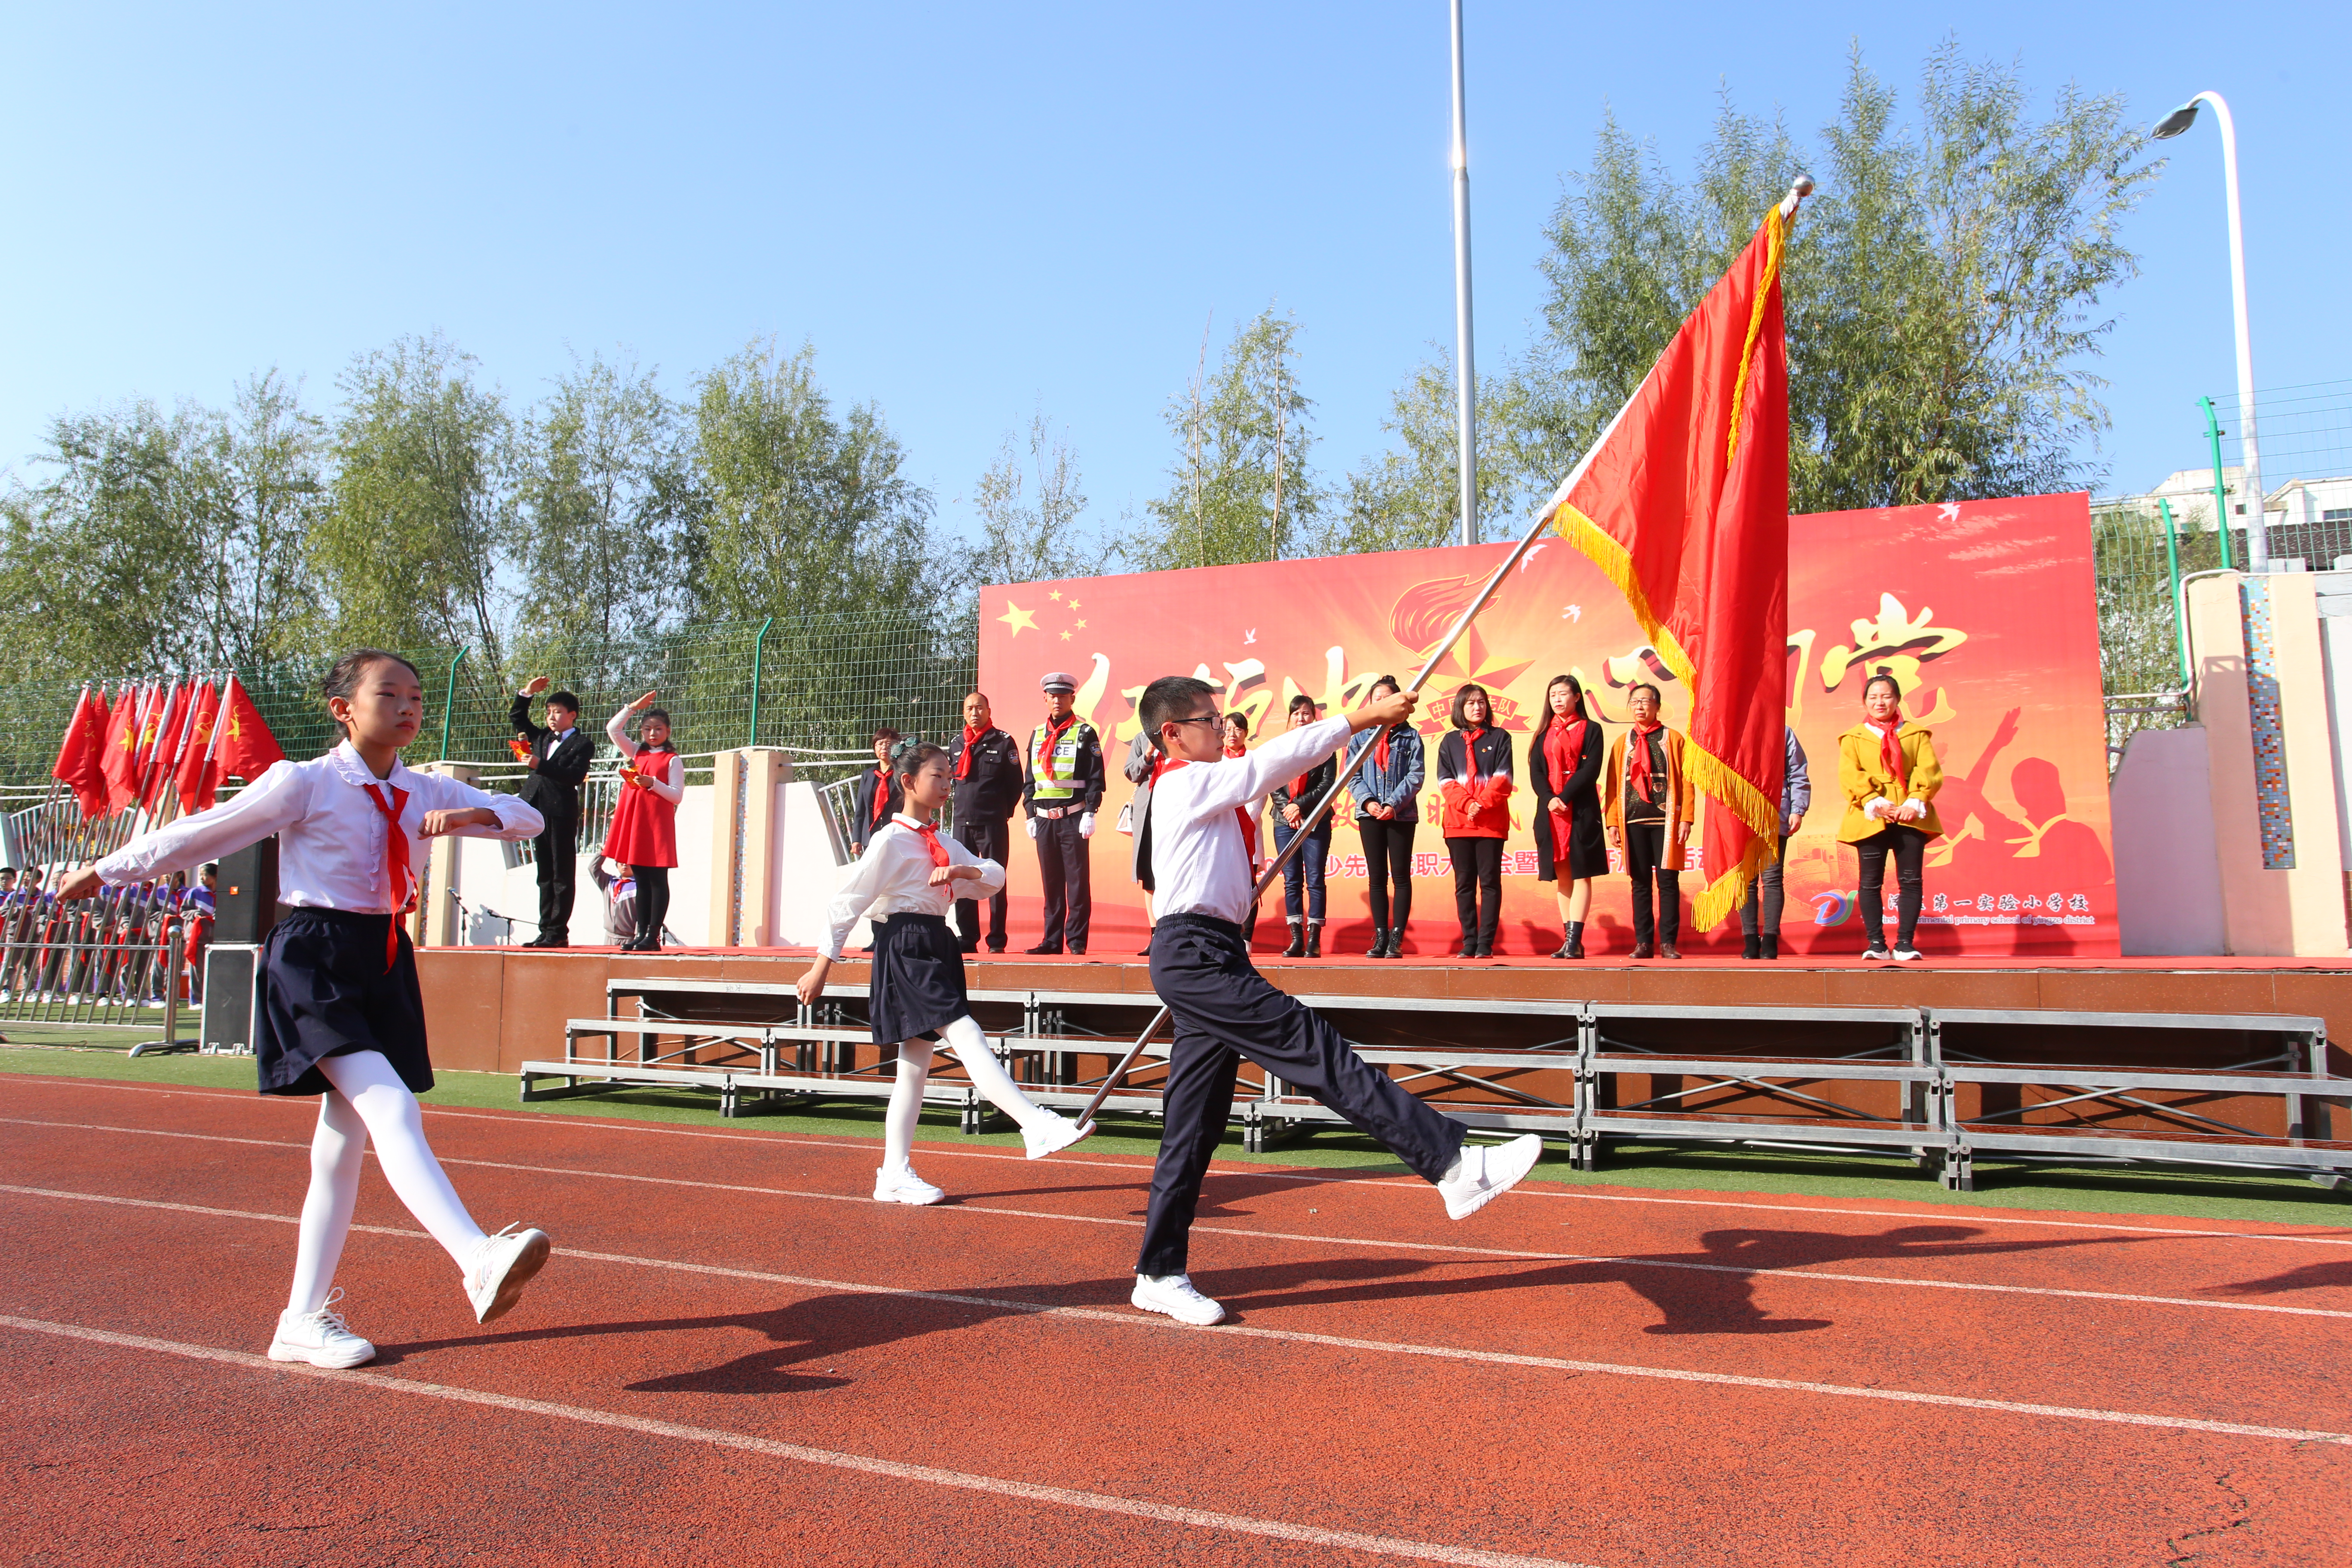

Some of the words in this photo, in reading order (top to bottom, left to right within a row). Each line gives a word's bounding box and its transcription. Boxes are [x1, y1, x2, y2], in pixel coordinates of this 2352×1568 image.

[1956, 916, 1989, 925] primary
[1991, 915, 2020, 924] school
[2021, 915, 2032, 924] of
[2033, 916, 2062, 925] yingze
[2064, 915, 2094, 924] district
